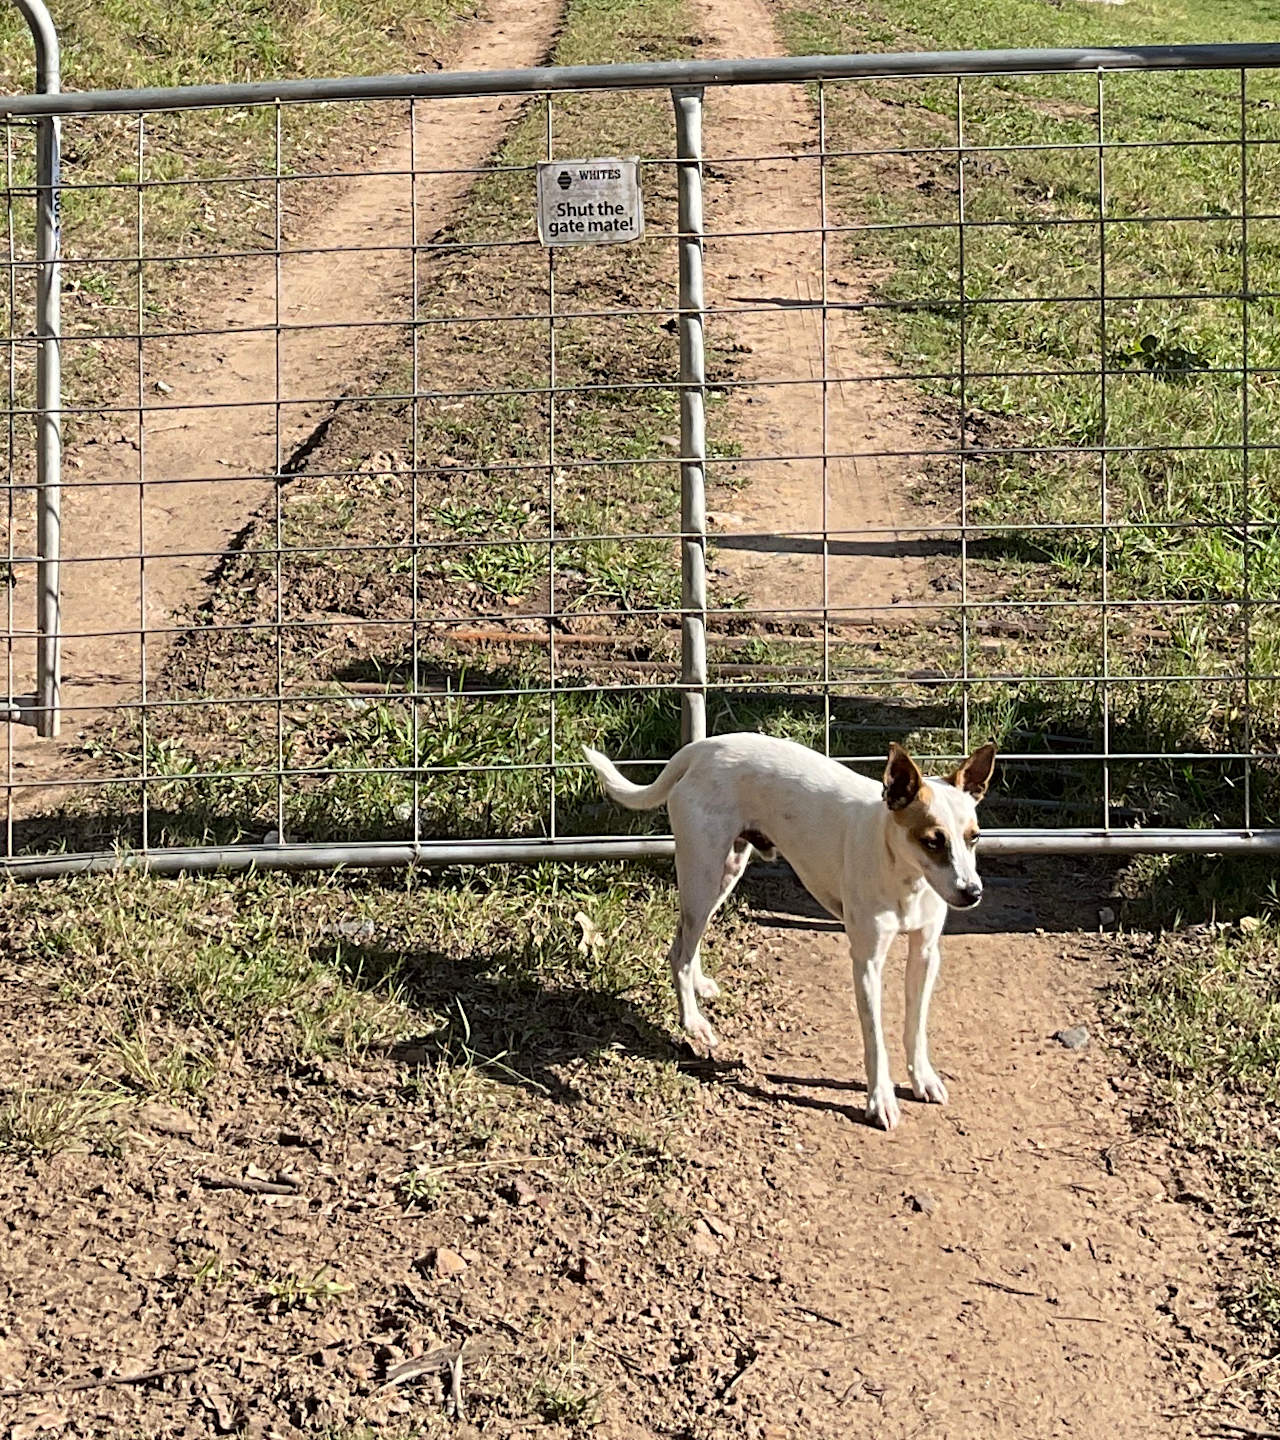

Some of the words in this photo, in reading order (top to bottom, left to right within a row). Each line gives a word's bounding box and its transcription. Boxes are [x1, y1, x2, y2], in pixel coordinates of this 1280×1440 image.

[579, 169, 621, 180] WHITES
[557, 202, 594, 217] Shut
[597, 201, 624, 215] the
[549, 220, 584, 237] gate
[588, 217, 633, 232] mate!
